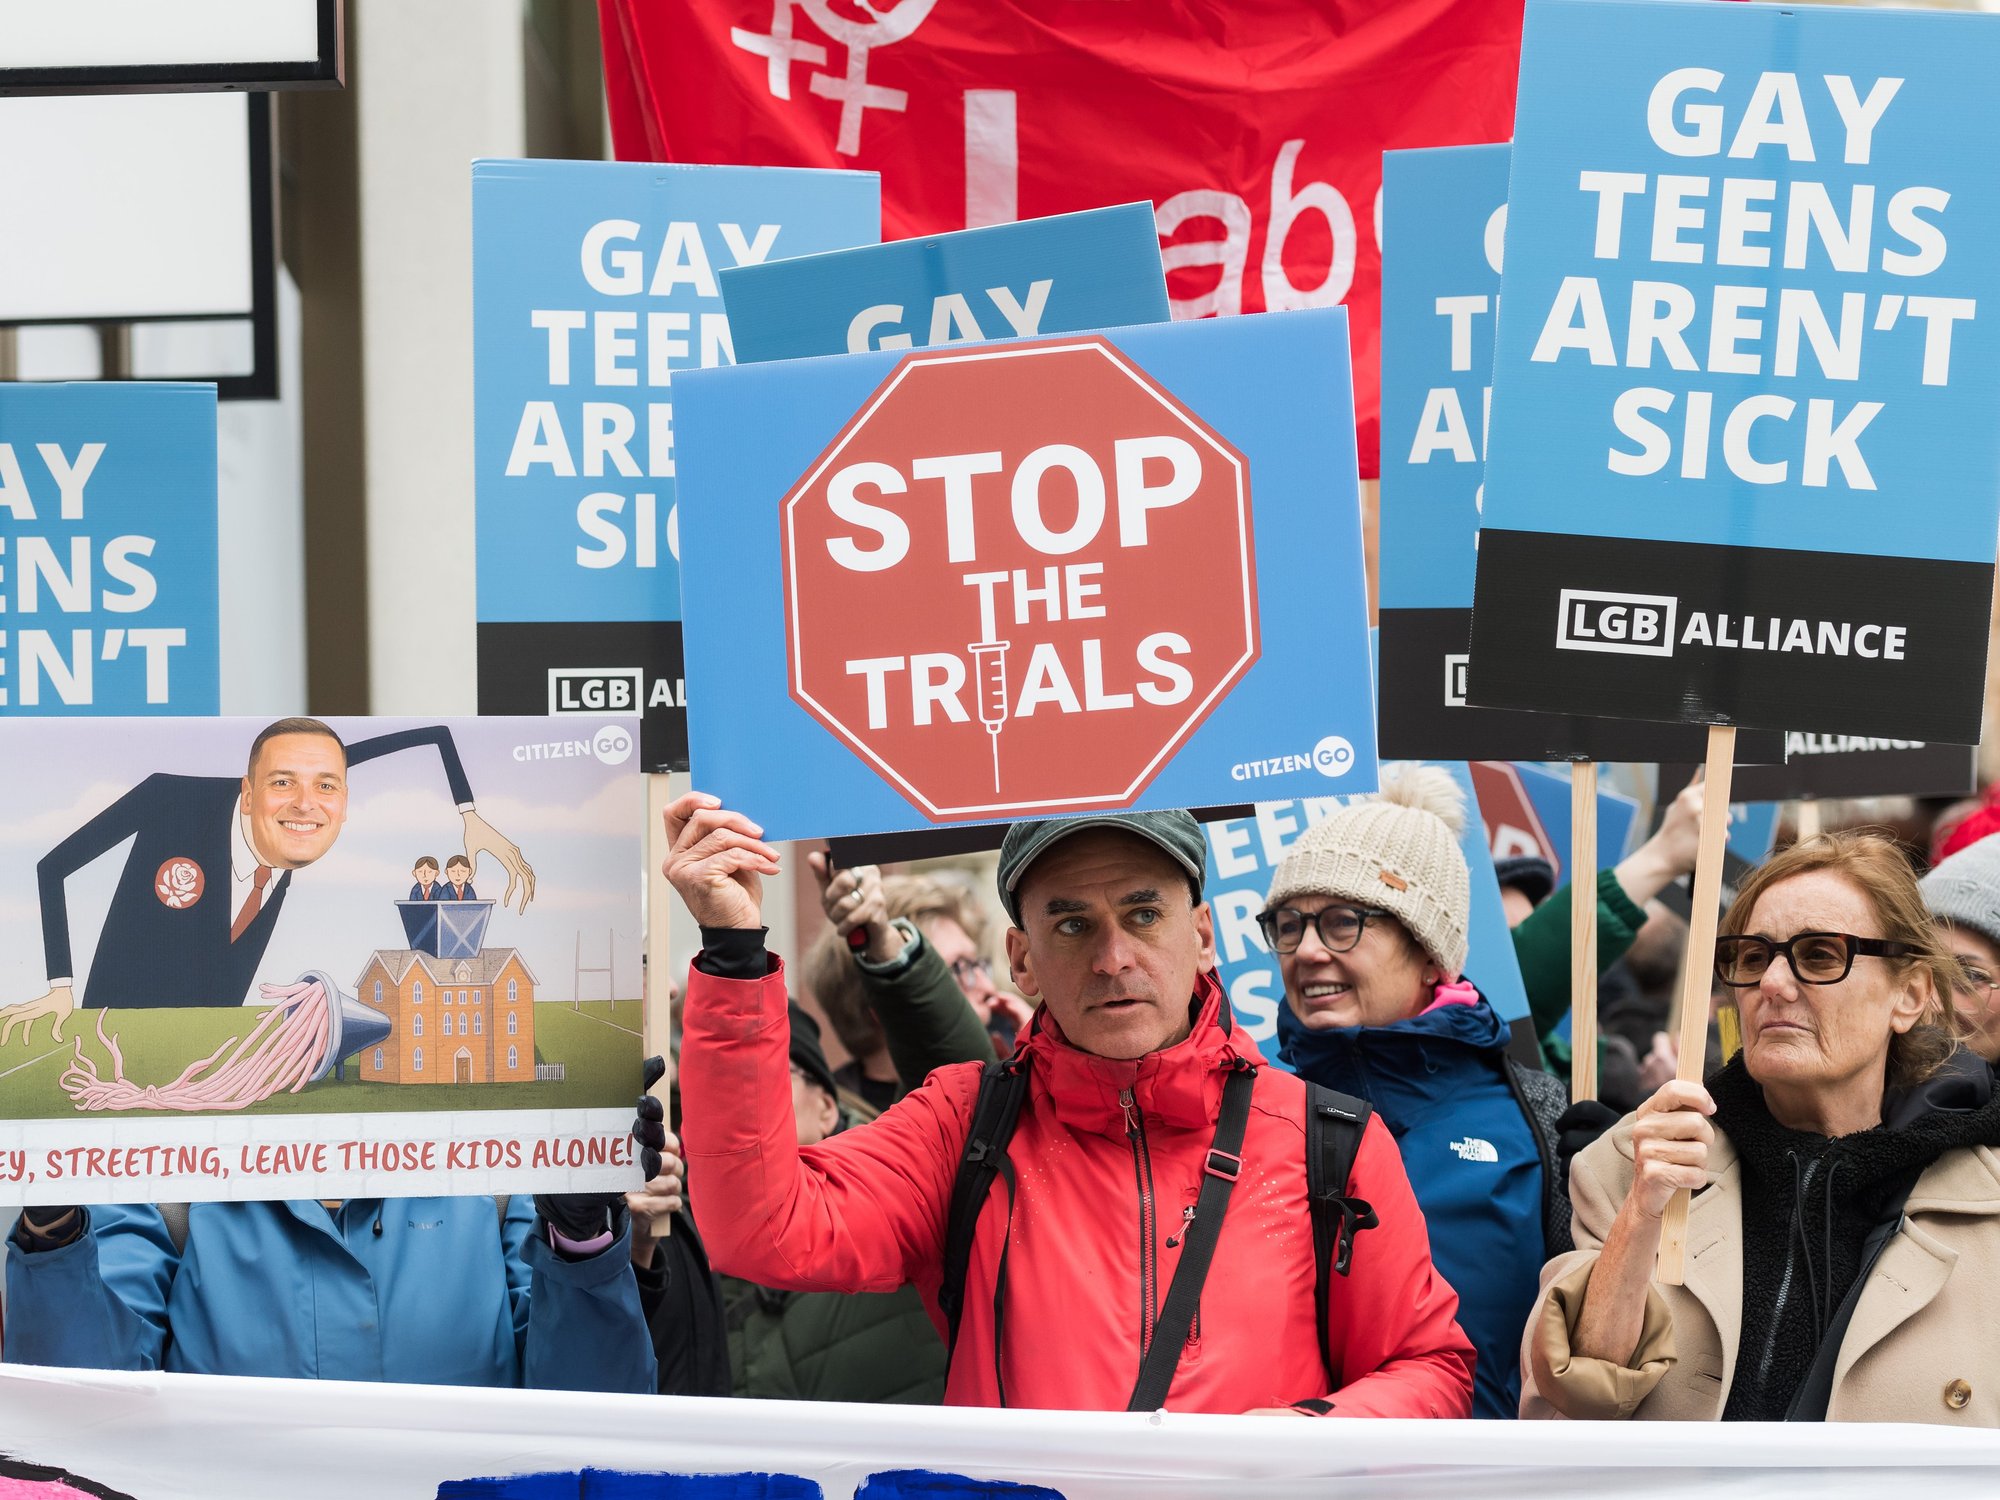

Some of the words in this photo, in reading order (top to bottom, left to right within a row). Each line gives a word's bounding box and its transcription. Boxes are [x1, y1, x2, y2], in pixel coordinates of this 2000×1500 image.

[1647, 67, 1904, 165] GAY
[581, 219, 781, 297] GAY
[1579, 171, 1951, 276] TEENS
[1531, 276, 1976, 386] AREN'T
[1608, 387, 1885, 490] SICK
[576, 492, 679, 568] SI
[826, 436, 1202, 572] STOP
[0, 535, 157, 613] NS
[963, 562, 1106, 643] THE
[0, 628, 186, 706] N'T
[1574, 604, 1658, 640] LGB
[1681, 612, 1906, 659] ALLIANCE
[561, 679, 630, 709] LGB
[846, 632, 1193, 735] TRIALS
[46, 1146, 229, 1179] STREETING,
[241, 1143, 327, 1174] LEAVE
[338, 1141, 436, 1172] THOSE
[447, 1140, 529, 1169] KIDS
[532, 1133, 634, 1168] ALONE!
[1450, 1141, 1480, 1155] NORTH
